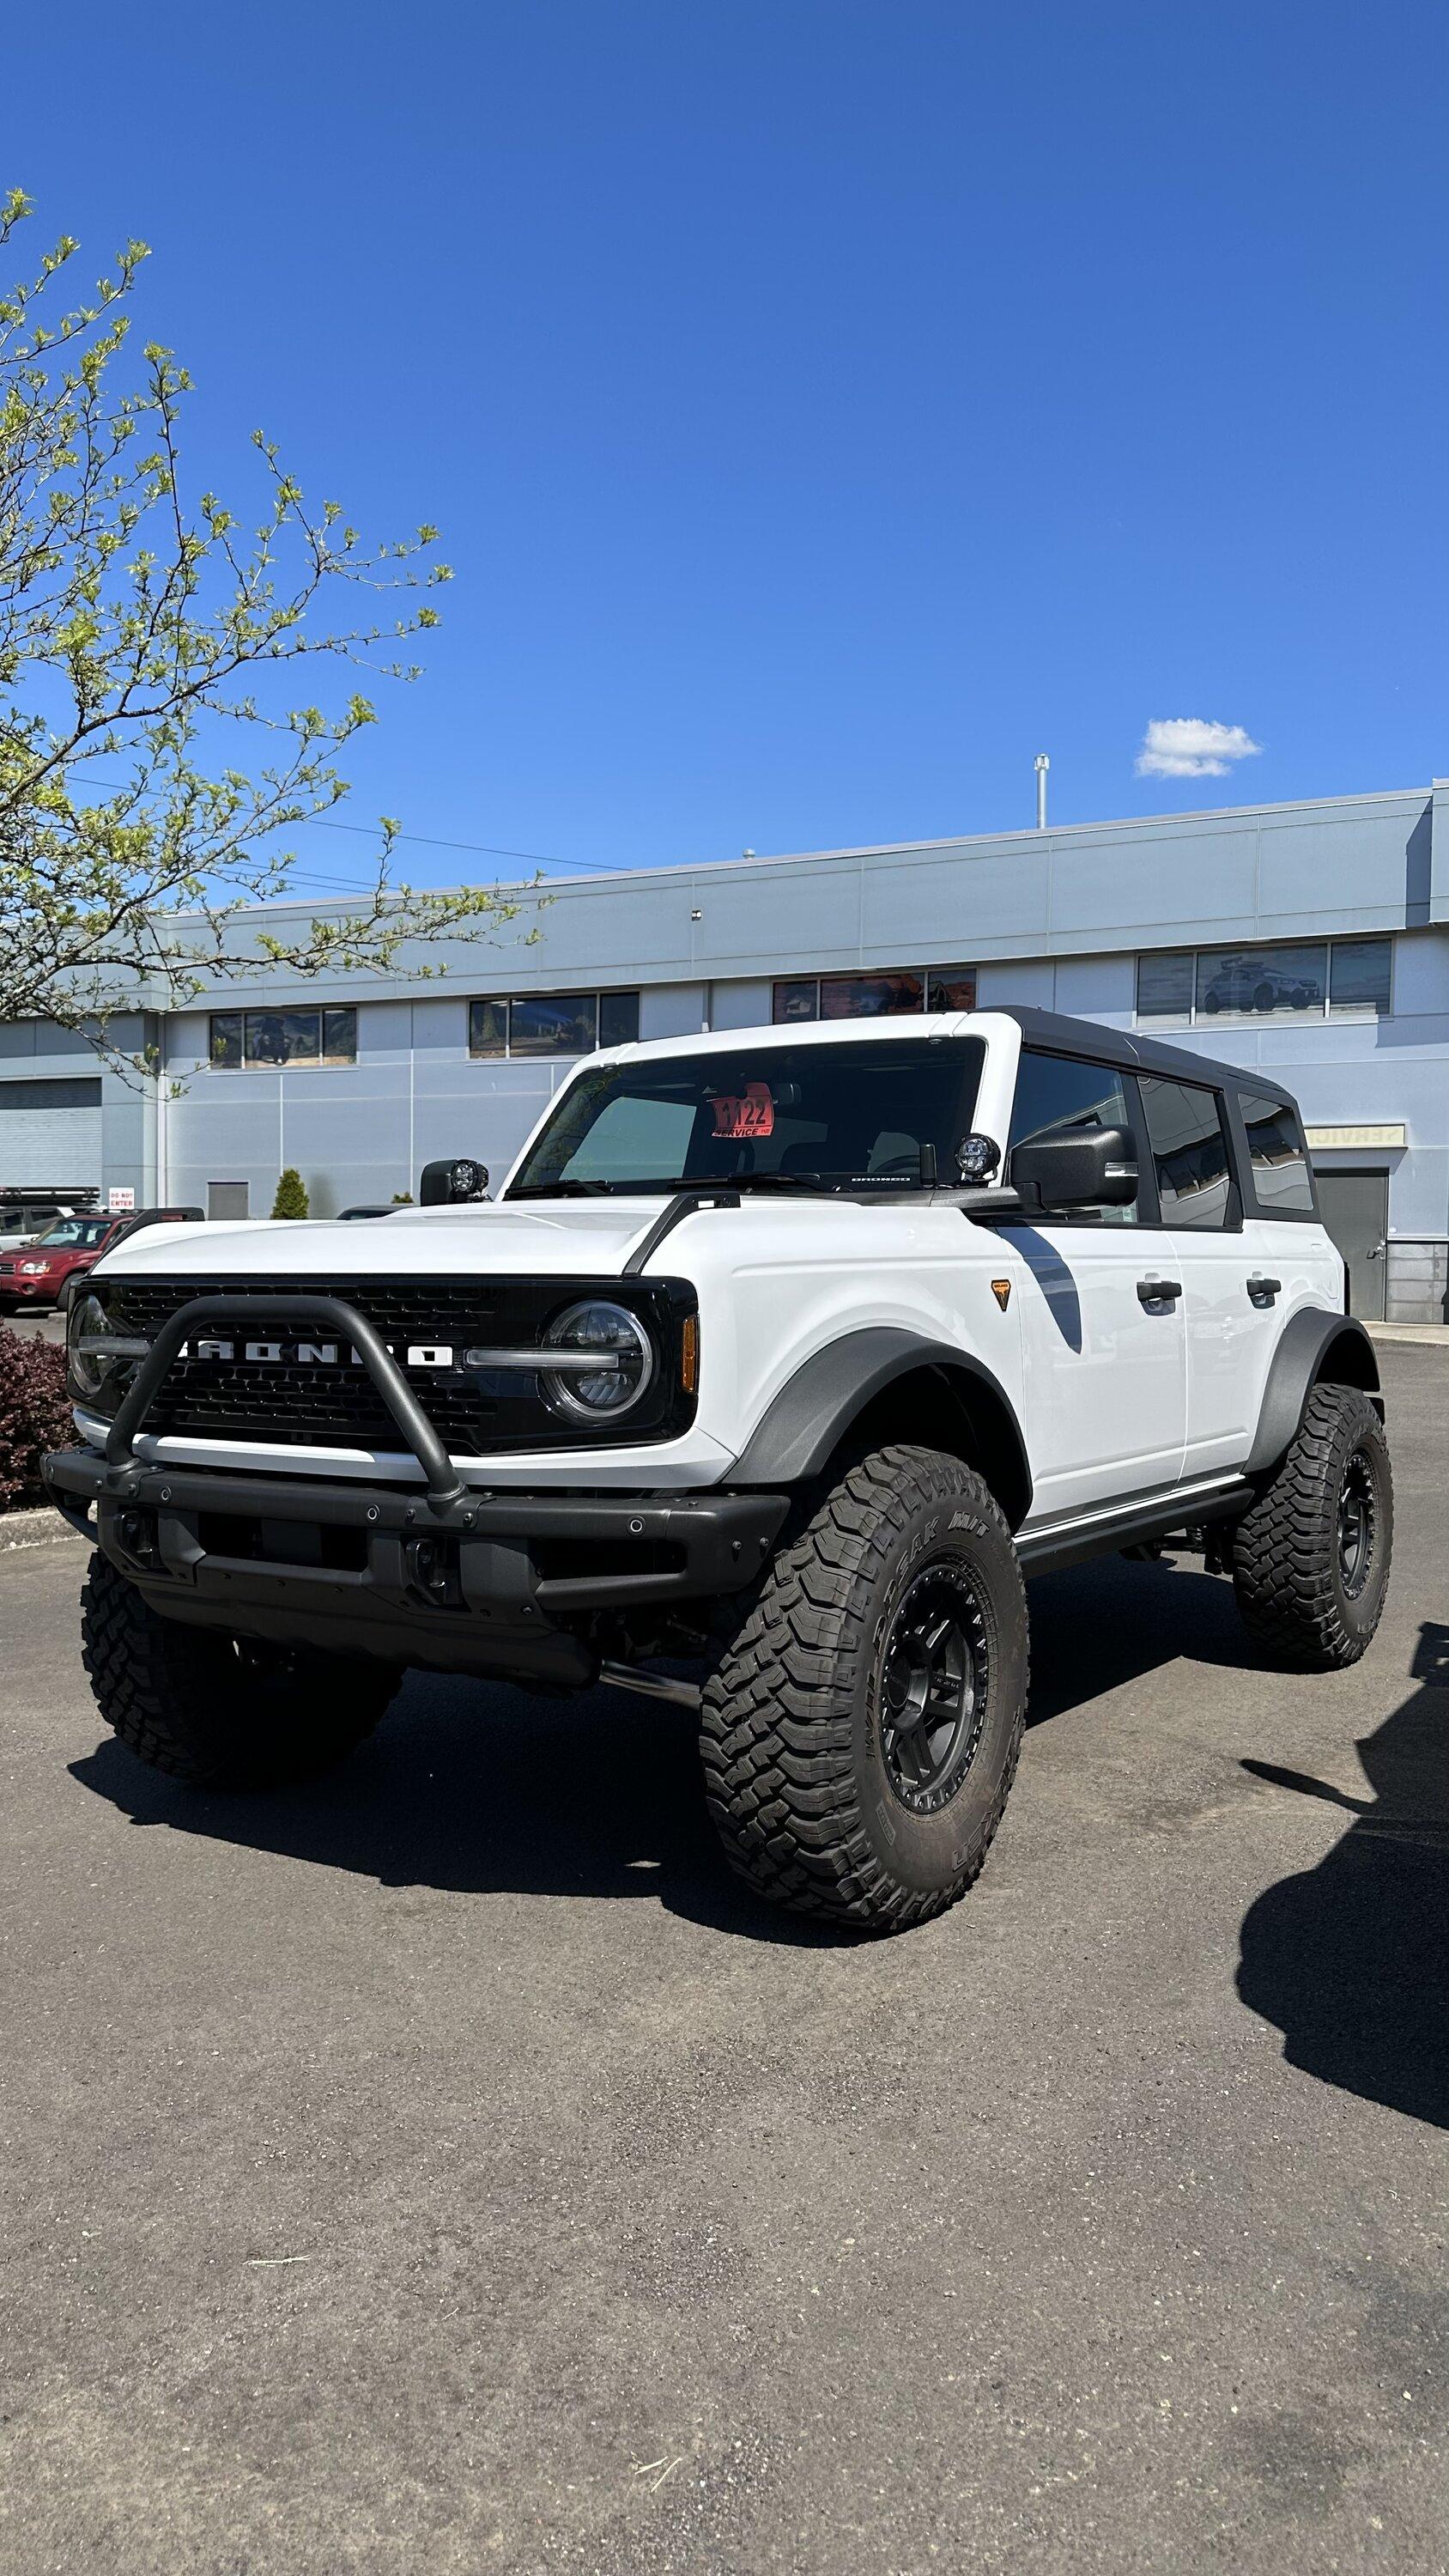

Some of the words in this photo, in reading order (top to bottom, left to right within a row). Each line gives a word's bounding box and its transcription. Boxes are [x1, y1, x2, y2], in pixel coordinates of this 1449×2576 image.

[722, 1099, 766, 1126] 1122
[714, 1127, 759, 1137] SERVICE
[948, 1510, 991, 1537] M/T
